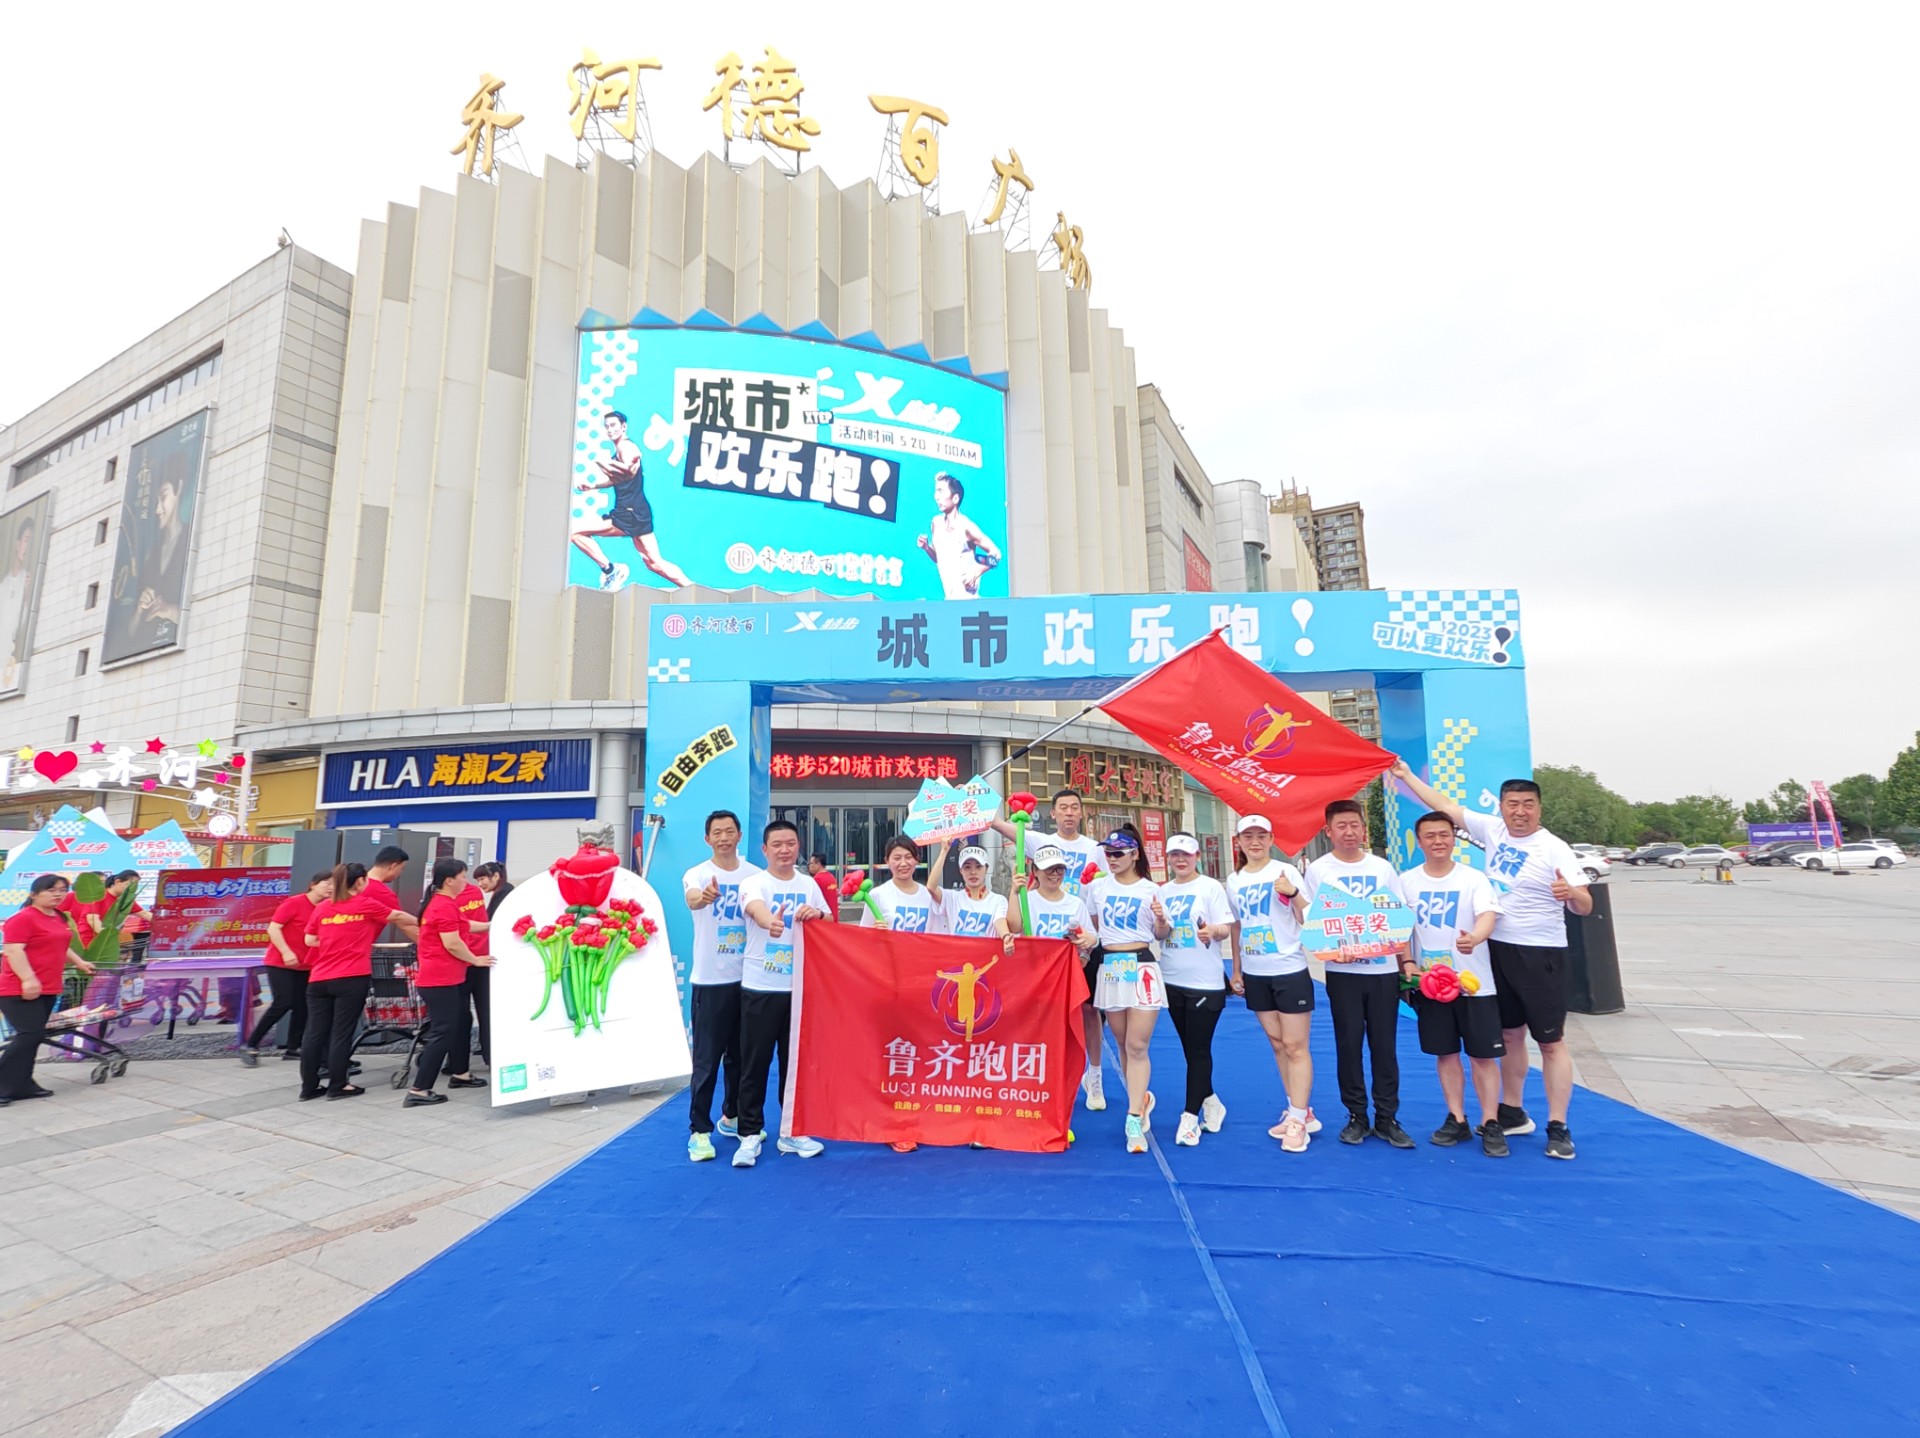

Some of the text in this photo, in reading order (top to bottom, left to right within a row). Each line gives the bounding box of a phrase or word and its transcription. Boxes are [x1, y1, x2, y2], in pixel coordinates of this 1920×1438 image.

[684, 378, 791, 433] 城市
[838, 424, 895, 446] 活动时间
[693, 430, 892, 515] 欢乐跑!
[689, 615, 756, 636] 齐河德百
[1446, 620, 1492, 640] 2023
[349, 749, 549, 791] HLA 海澜之家
[660, 726, 735, 794] 自由奔跑
[768, 754, 959, 779] 特步520城市欢乐跑
[1241, 774, 1281, 799] GROUP
[924, 799, 978, 823] 二等奖
[1323, 913, 1390, 936] 四等奖
[883, 1037, 1047, 1085] 鲁齐跑团
[881, 1081, 1050, 1103] LUQI RUNNING GROUP
